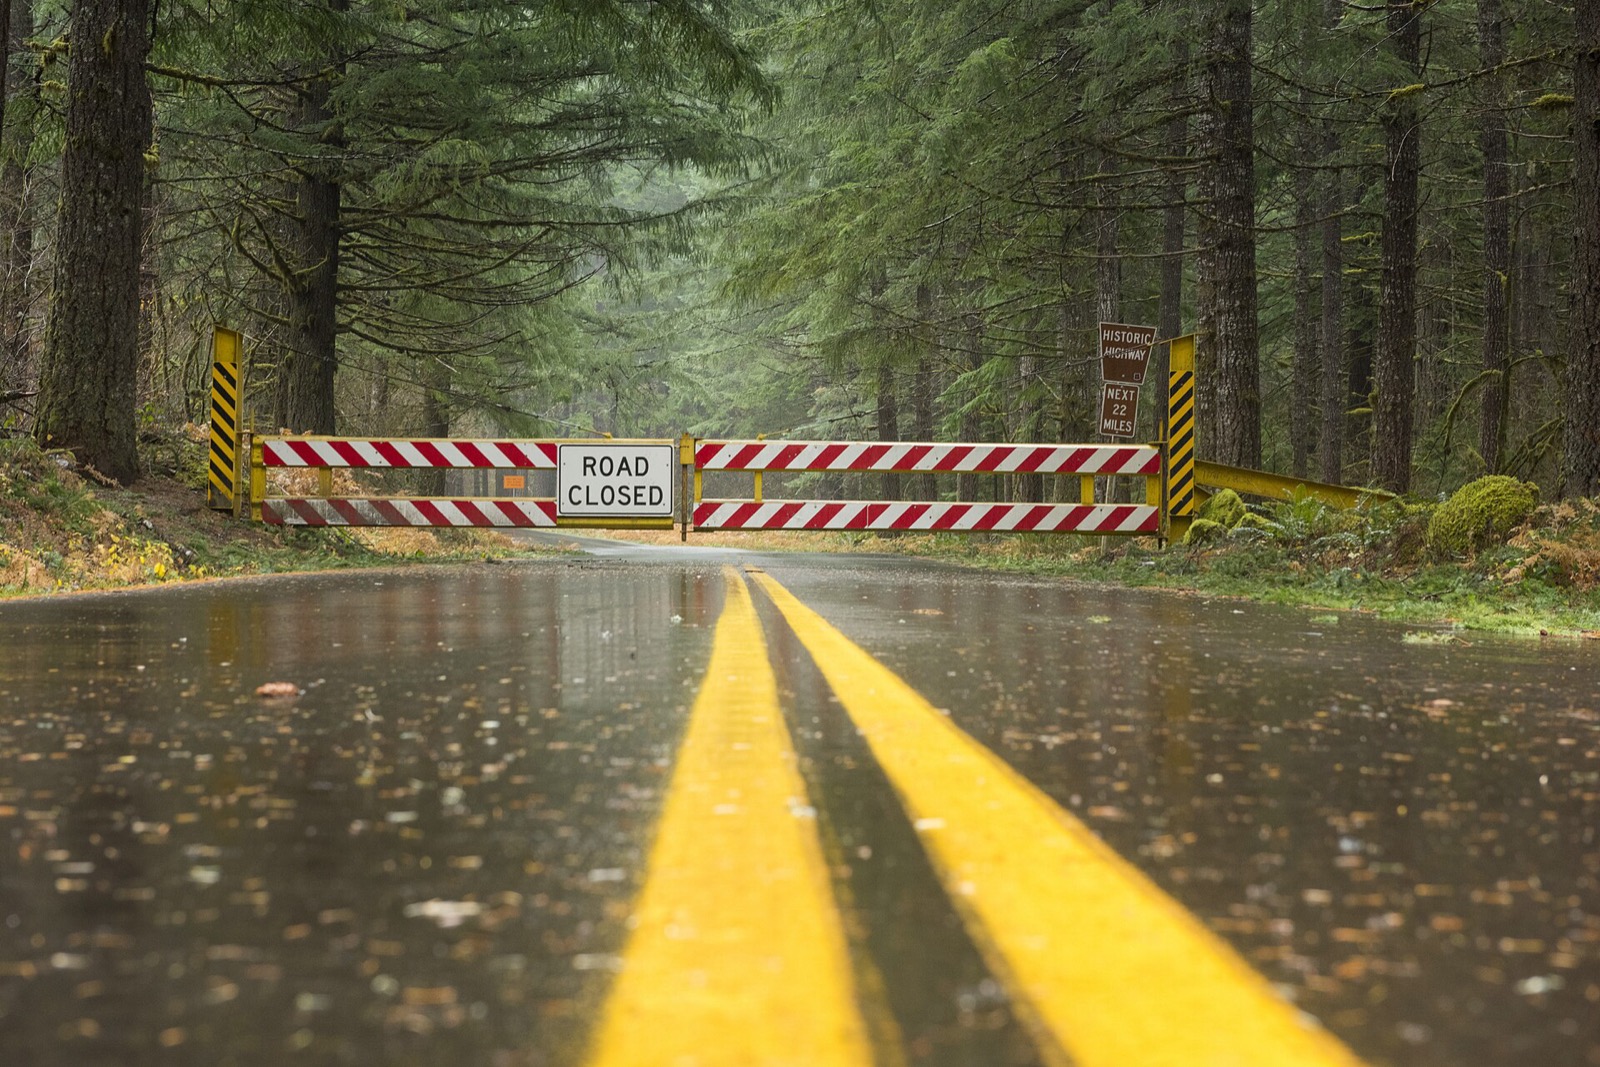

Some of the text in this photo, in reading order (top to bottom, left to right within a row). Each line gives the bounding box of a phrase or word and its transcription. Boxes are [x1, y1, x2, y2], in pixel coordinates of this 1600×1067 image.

[1103, 329, 1151, 345] HISTORIC
[1107, 388, 1135, 401] NEXT
[1112, 404, 1127, 416] 22
[1103, 418, 1132, 432] MILES
[583, 456, 649, 477] ROAD
[568, 485, 663, 506] CLOSED
